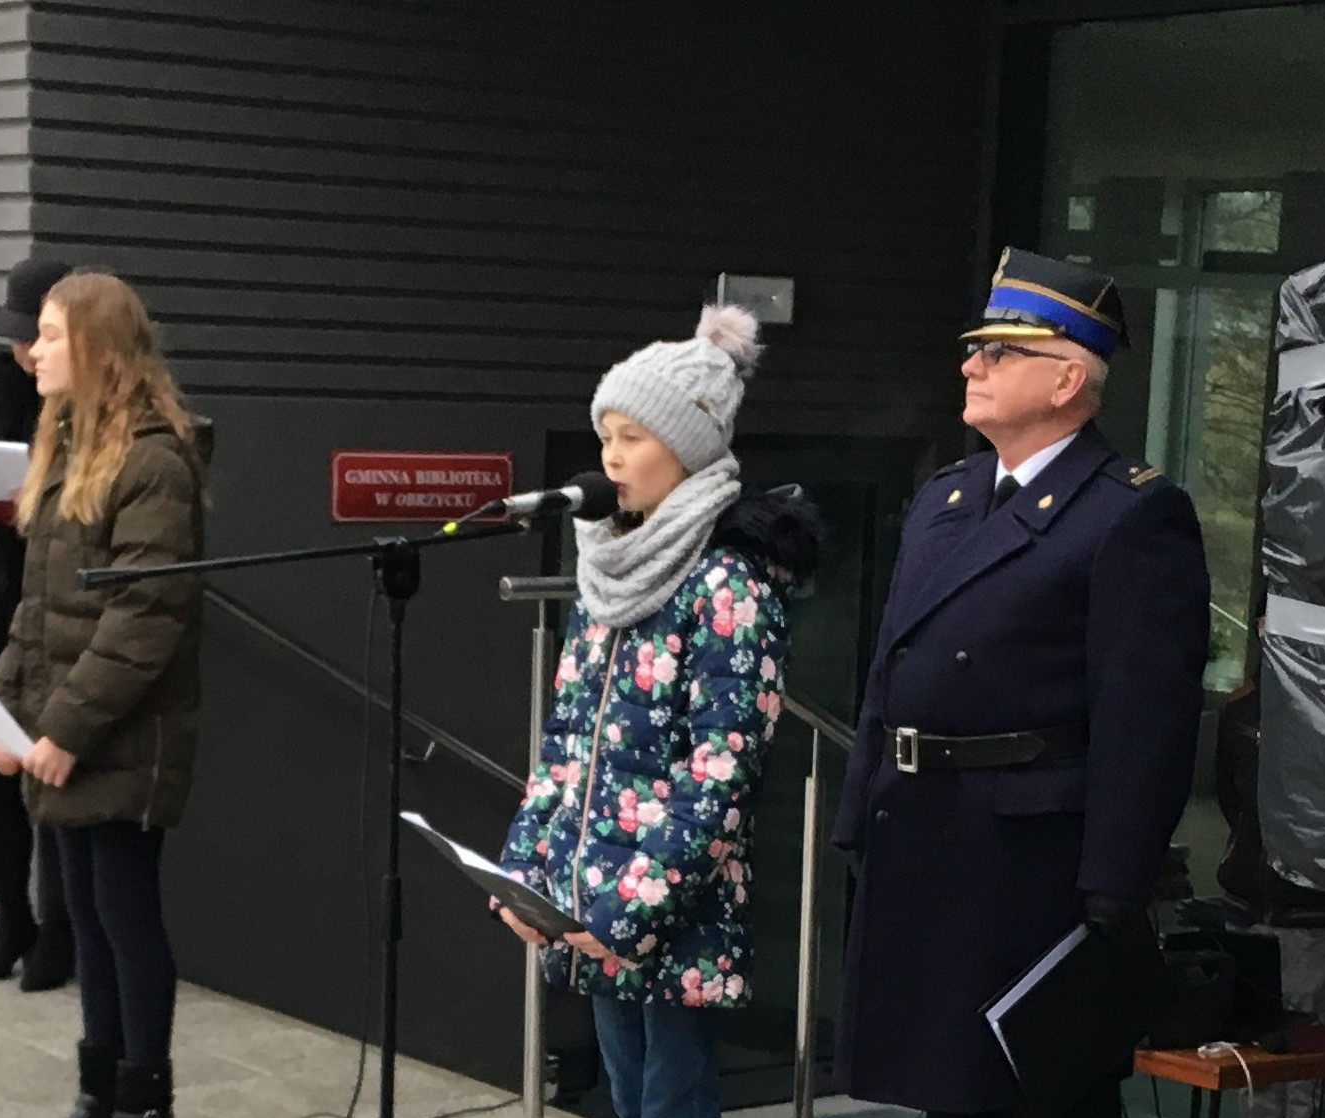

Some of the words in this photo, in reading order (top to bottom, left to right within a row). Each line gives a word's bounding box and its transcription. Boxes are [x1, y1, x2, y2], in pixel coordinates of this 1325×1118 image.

[345, 469, 411, 485] GMINNA
[416, 470, 503, 486] BIBLIOTEKA
[375, 492, 391, 507] W
[395, 493, 475, 508] OBRZYCKU
